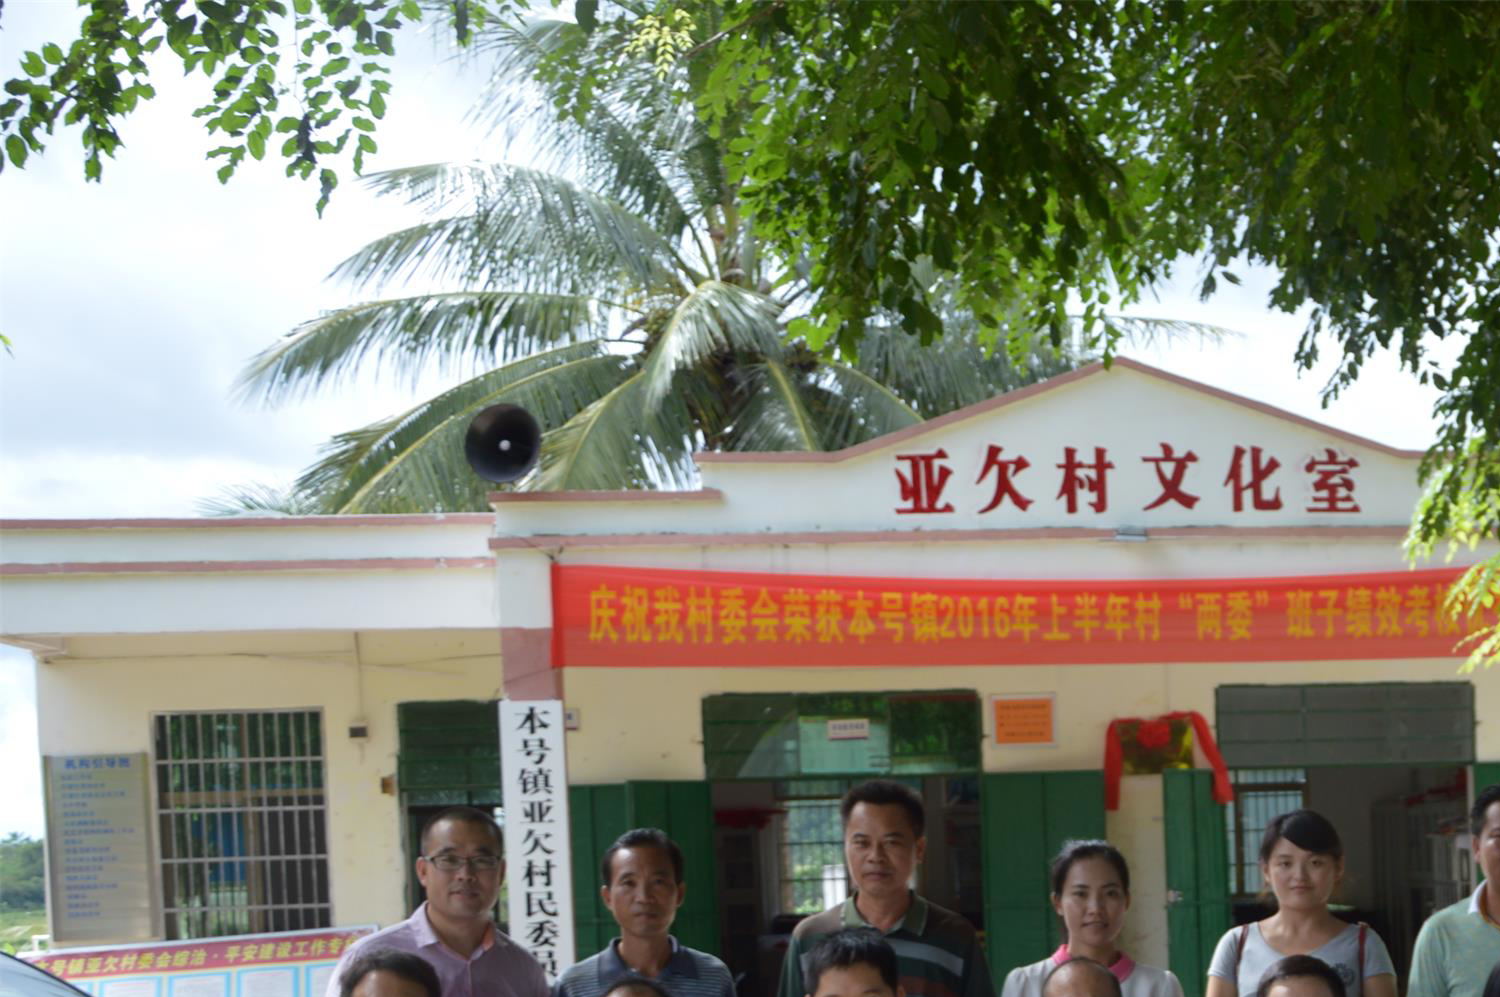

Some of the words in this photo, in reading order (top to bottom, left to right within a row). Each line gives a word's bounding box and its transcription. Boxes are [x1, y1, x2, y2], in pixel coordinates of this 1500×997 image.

[895, 442, 1362, 514] 亚欠村文化室
